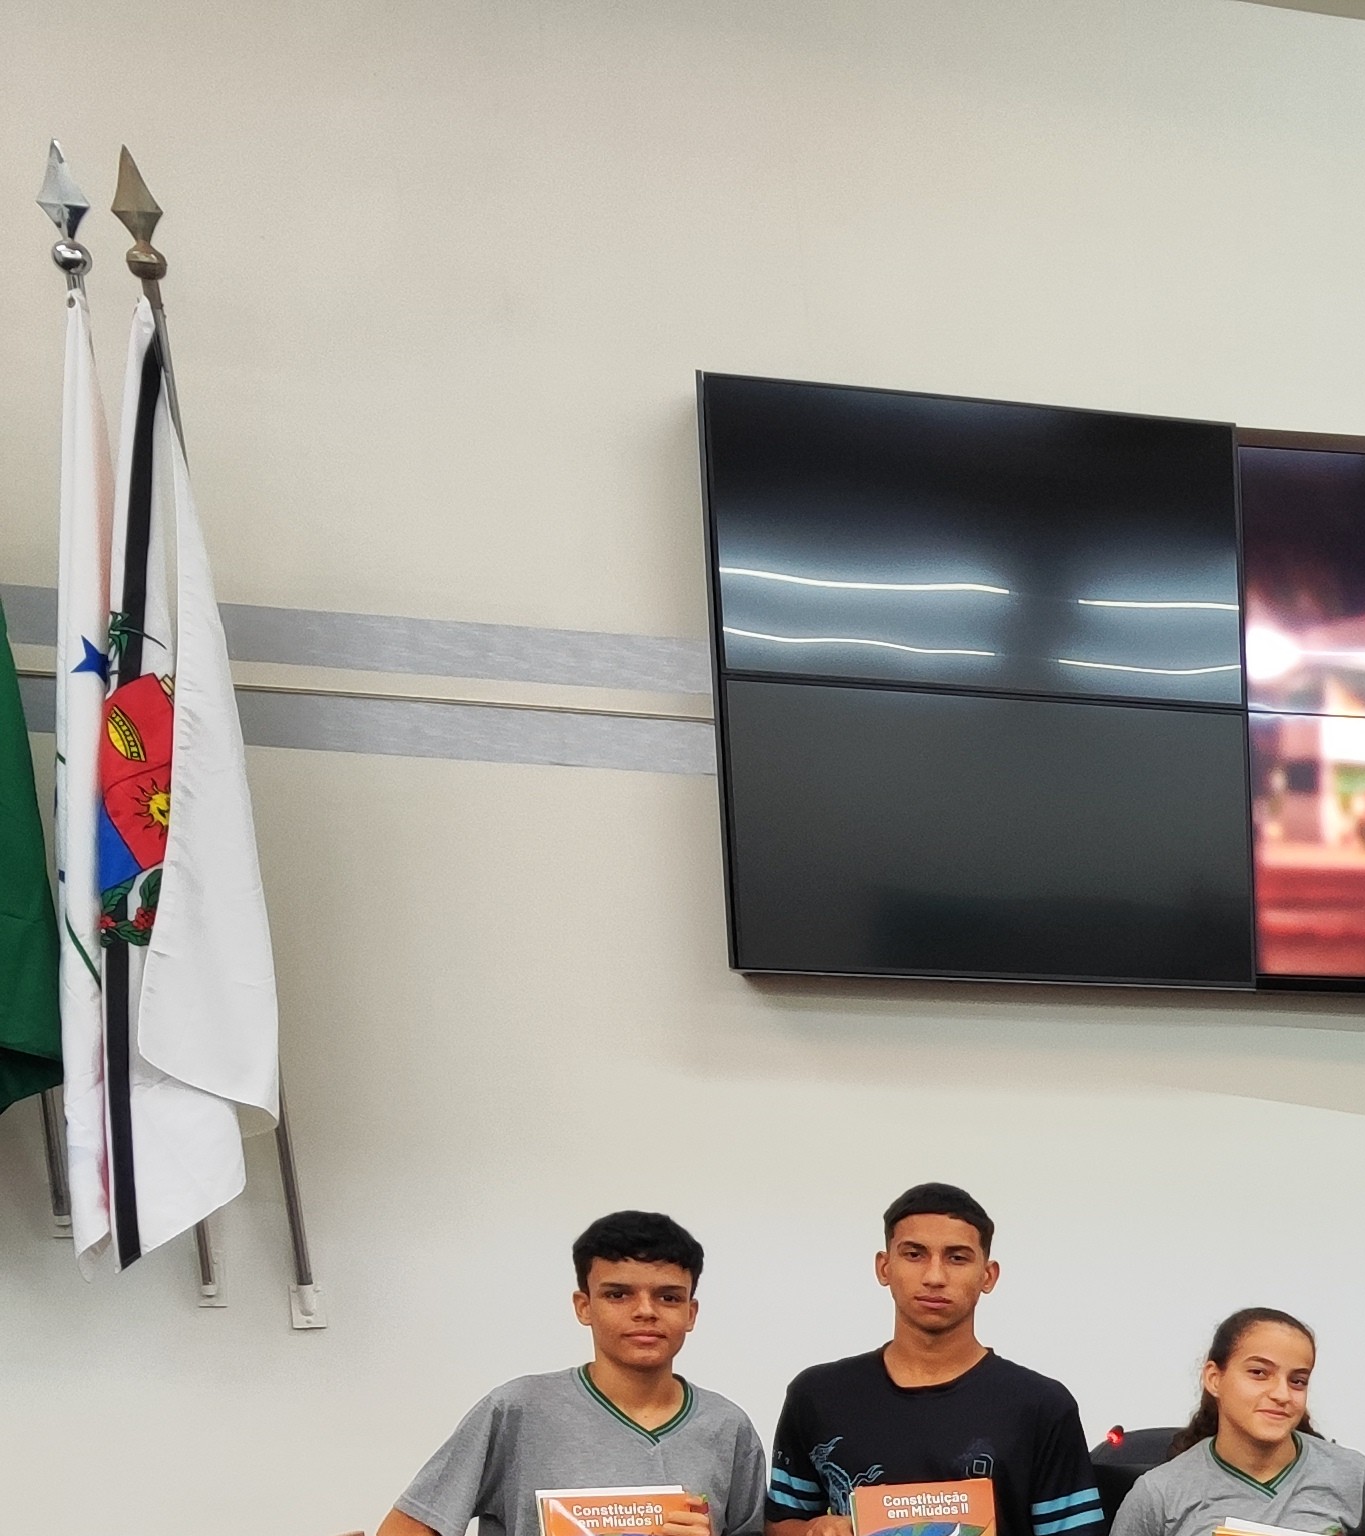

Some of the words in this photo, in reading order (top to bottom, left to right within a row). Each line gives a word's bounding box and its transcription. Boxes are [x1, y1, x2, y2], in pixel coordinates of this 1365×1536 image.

[883, 1492, 968, 1506] Constituição
[572, 1502, 663, 1516] Constituição
[887, 1509, 909, 1519] em
[911, 1505, 959, 1518] Miúdos
[961, 1503, 969, 1514] II
[579, 1518, 599, 1528] em
[602, 1515, 652, 1527] Miúdos
[655, 1514, 663, 1526] II
